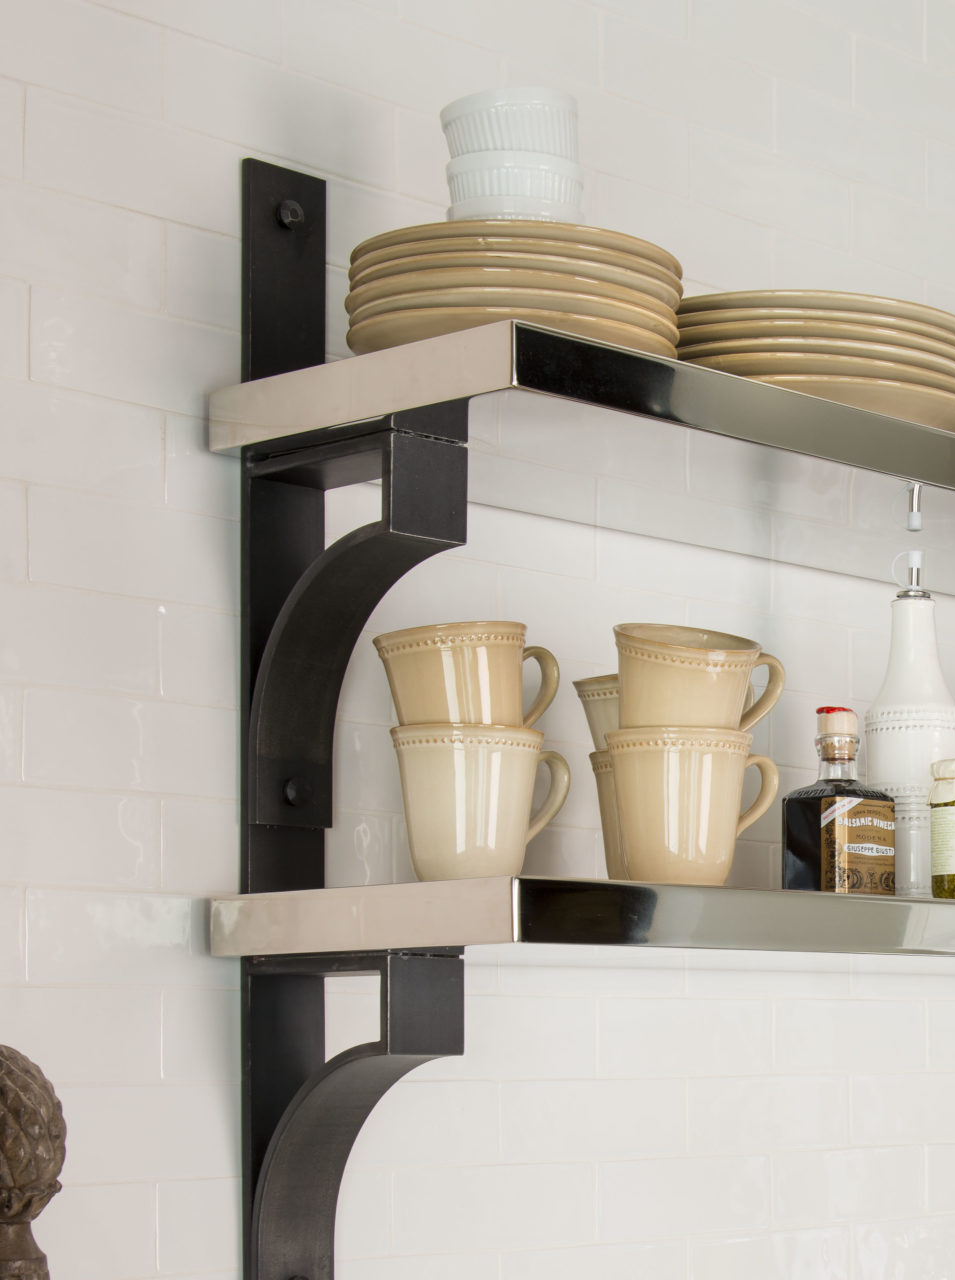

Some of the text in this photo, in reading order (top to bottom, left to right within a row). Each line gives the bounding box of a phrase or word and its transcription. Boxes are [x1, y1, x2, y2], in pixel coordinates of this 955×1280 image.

[837, 816, 872, 828] BALSAMIC
[856, 834, 887, 842] MODENA
[846, 844, 894, 856] GIUSEPPE GIUSTI
